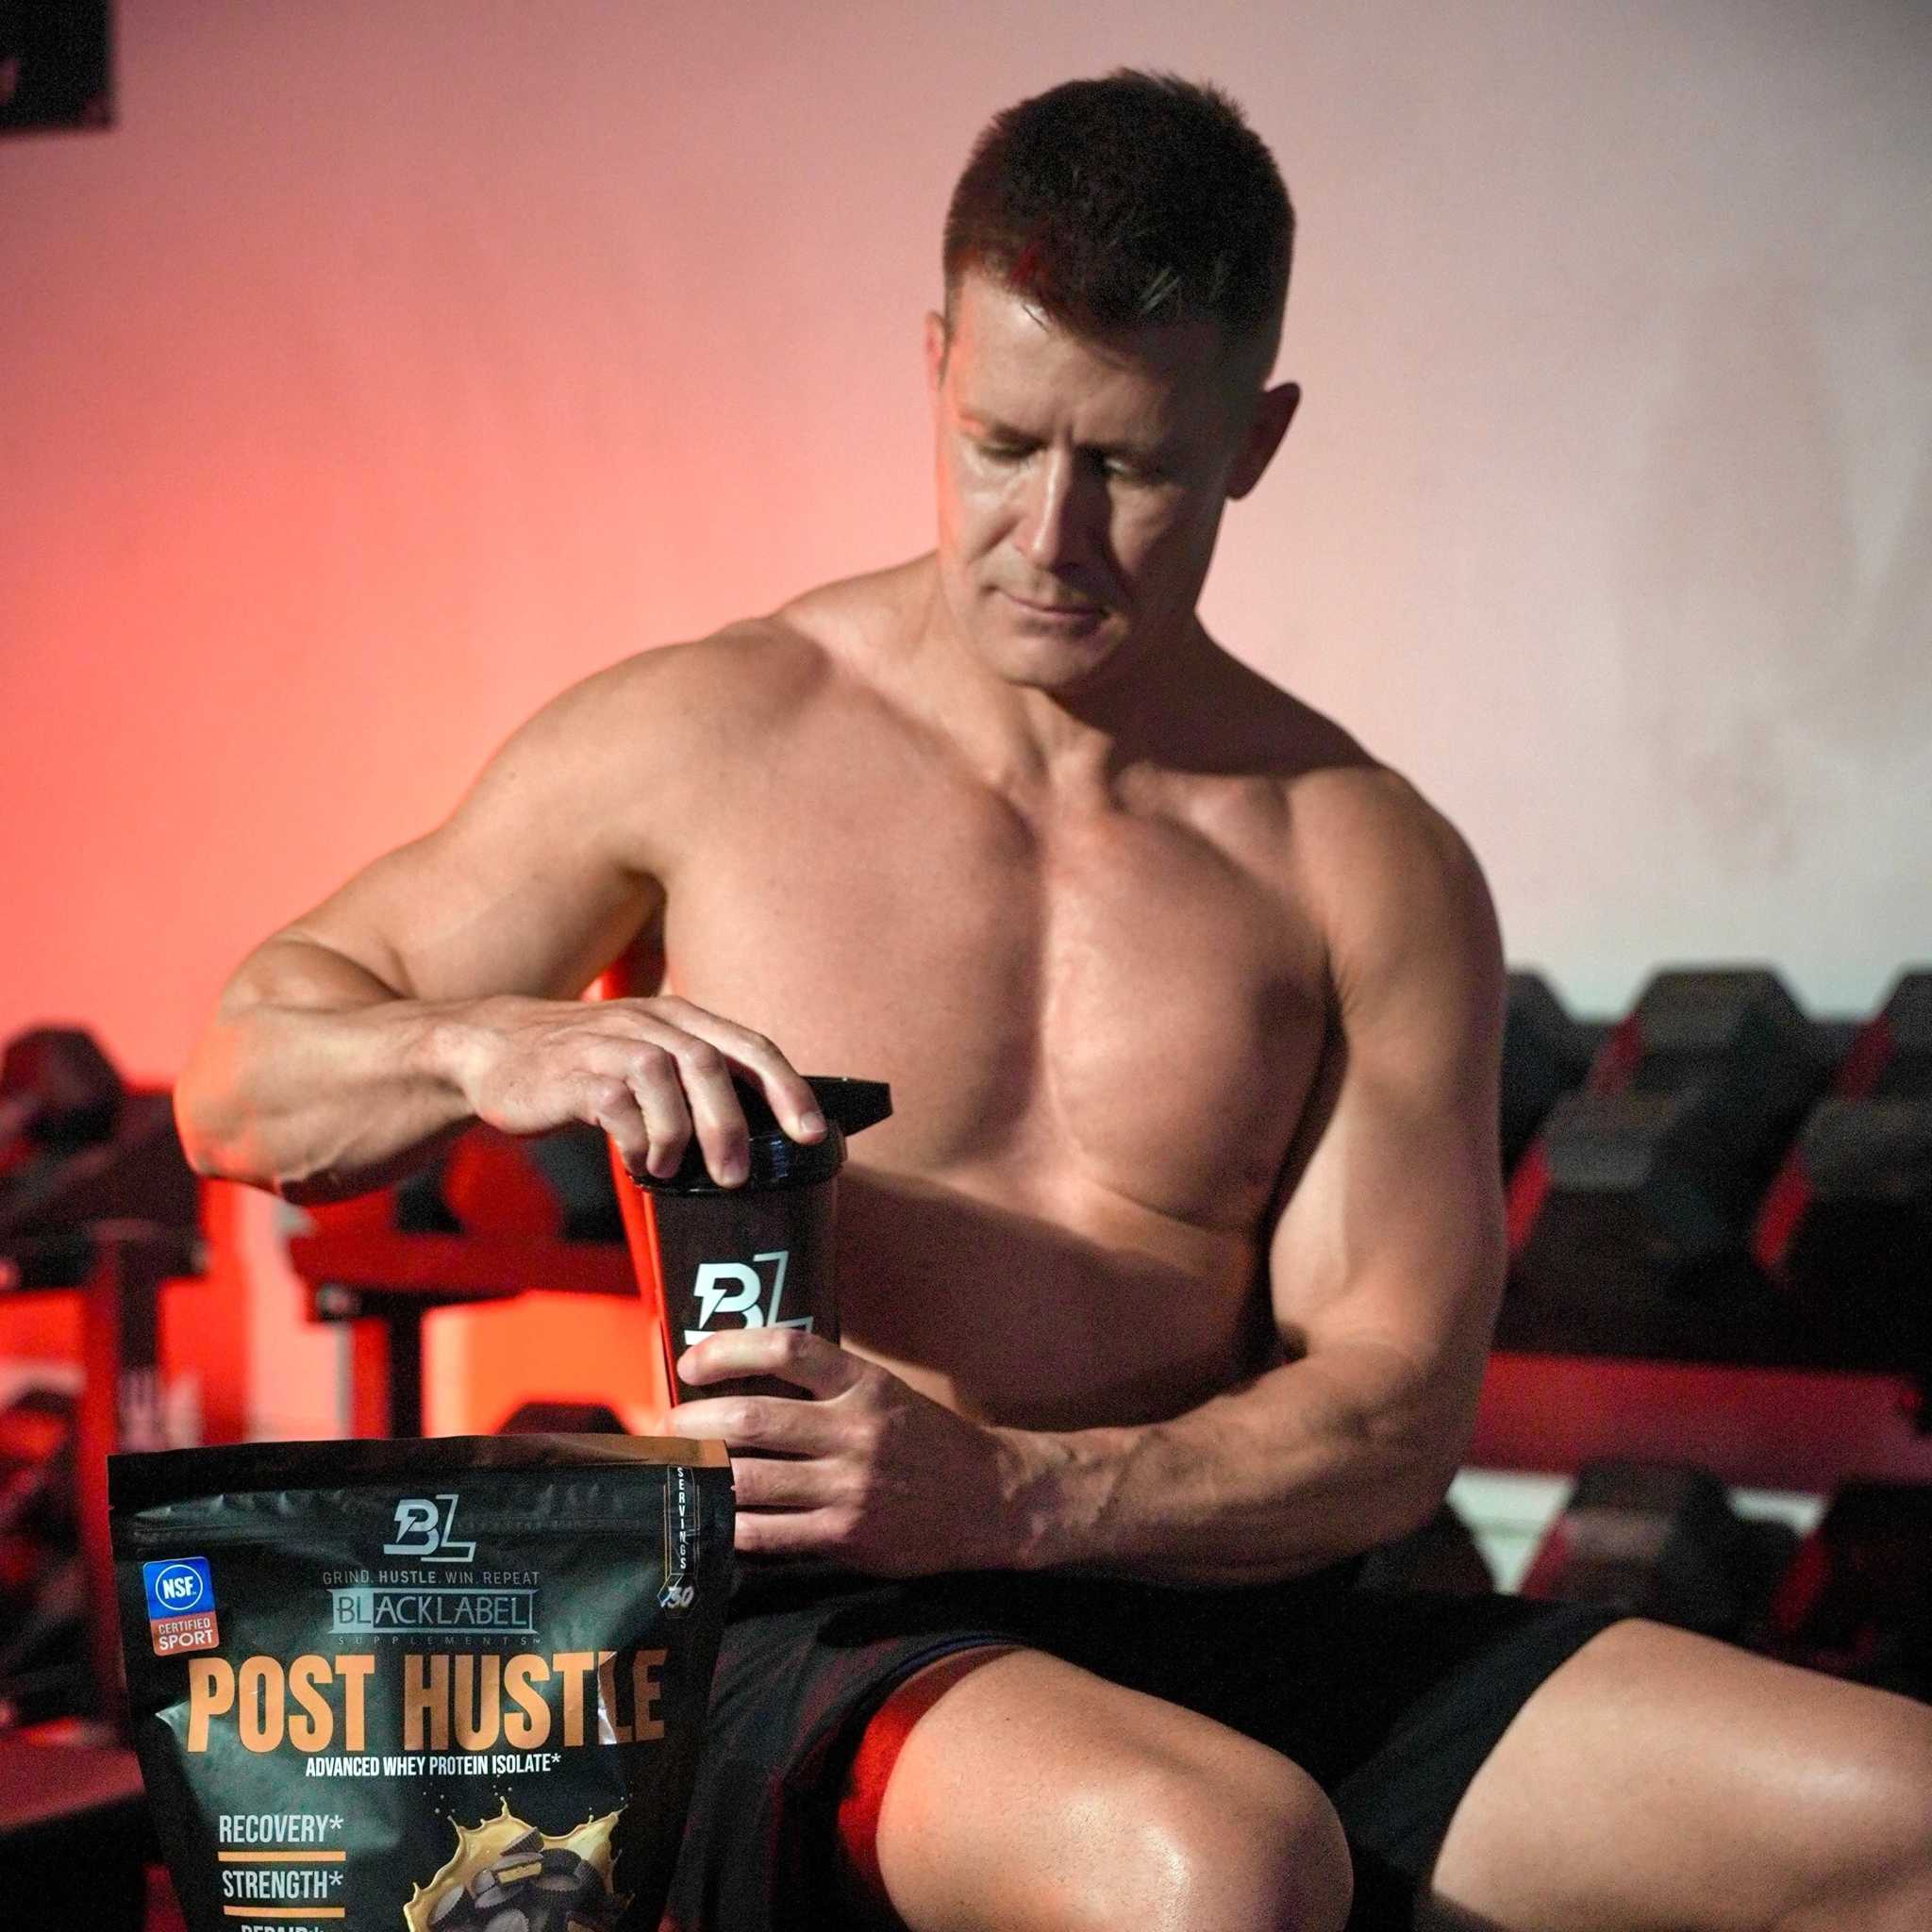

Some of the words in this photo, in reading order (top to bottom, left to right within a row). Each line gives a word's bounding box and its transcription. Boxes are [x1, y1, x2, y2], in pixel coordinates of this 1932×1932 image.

[677, 1467, 687, 1569] SERVINGS
[162, 1576, 194, 1599] NSF
[483, 1571, 541, 1585] REPEAT
[158, 1618, 210, 1635] CERTIFIED
[158, 1630, 213, 1651] SPORT
[187, 1654, 375, 1753] POST
[404, 1650, 666, 1752] HUSTLE
[306, 1757, 379, 1777] ADVANCED
[383, 1757, 426, 1776] WHEY
[429, 1756, 489, 1775] PROTEIN
